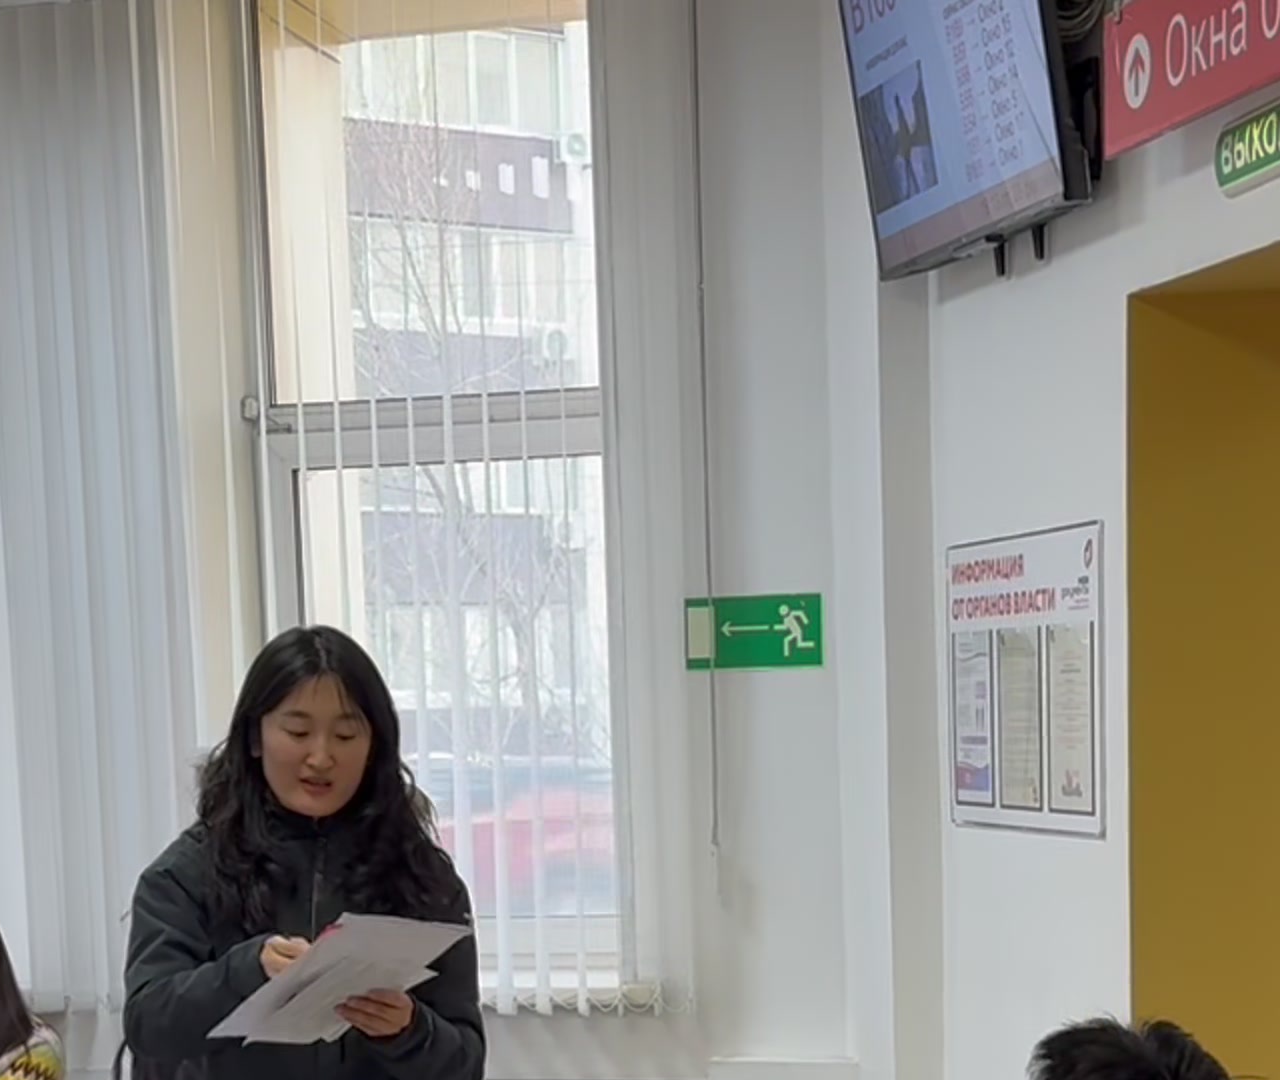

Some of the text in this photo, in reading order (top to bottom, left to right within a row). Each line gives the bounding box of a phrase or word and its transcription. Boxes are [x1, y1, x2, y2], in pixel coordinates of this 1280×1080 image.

[1164, 0, 1247, 87] Окна
[951, 553, 1024, 585] ИНФОРМАЦИЯ
[951, 597, 965, 620] ОТ
[966, 592, 1011, 619] ОРГАНОВ
[1013, 587, 1056, 614] ВЛАСТИ
